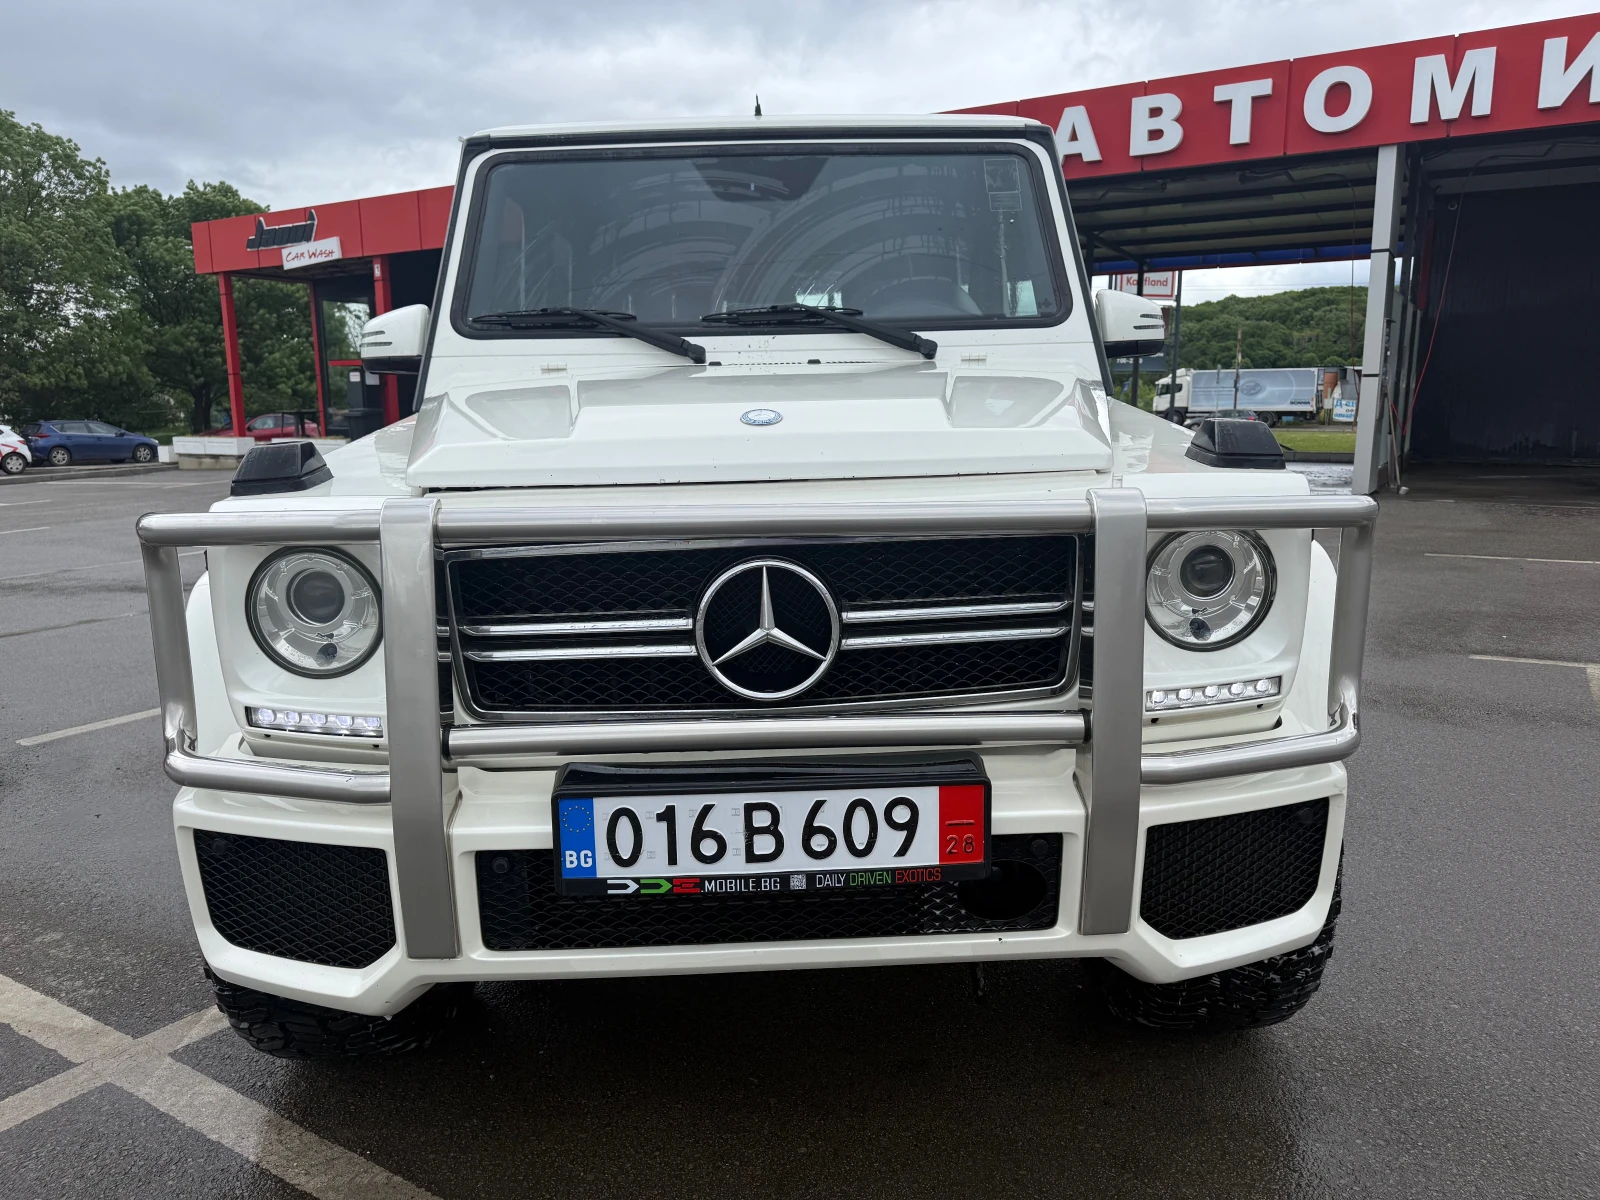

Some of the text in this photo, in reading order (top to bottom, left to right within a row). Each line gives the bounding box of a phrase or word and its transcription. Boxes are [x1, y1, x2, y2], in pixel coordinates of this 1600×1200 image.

[286, 248, 335, 262] CAR WASH
[1126, 276, 1168, 287] Kafland
[946, 834, 975, 855] 28
[565, 850, 593, 869] BG
[815, 868, 942, 888] DAILY DRIVEN EXOTICS
